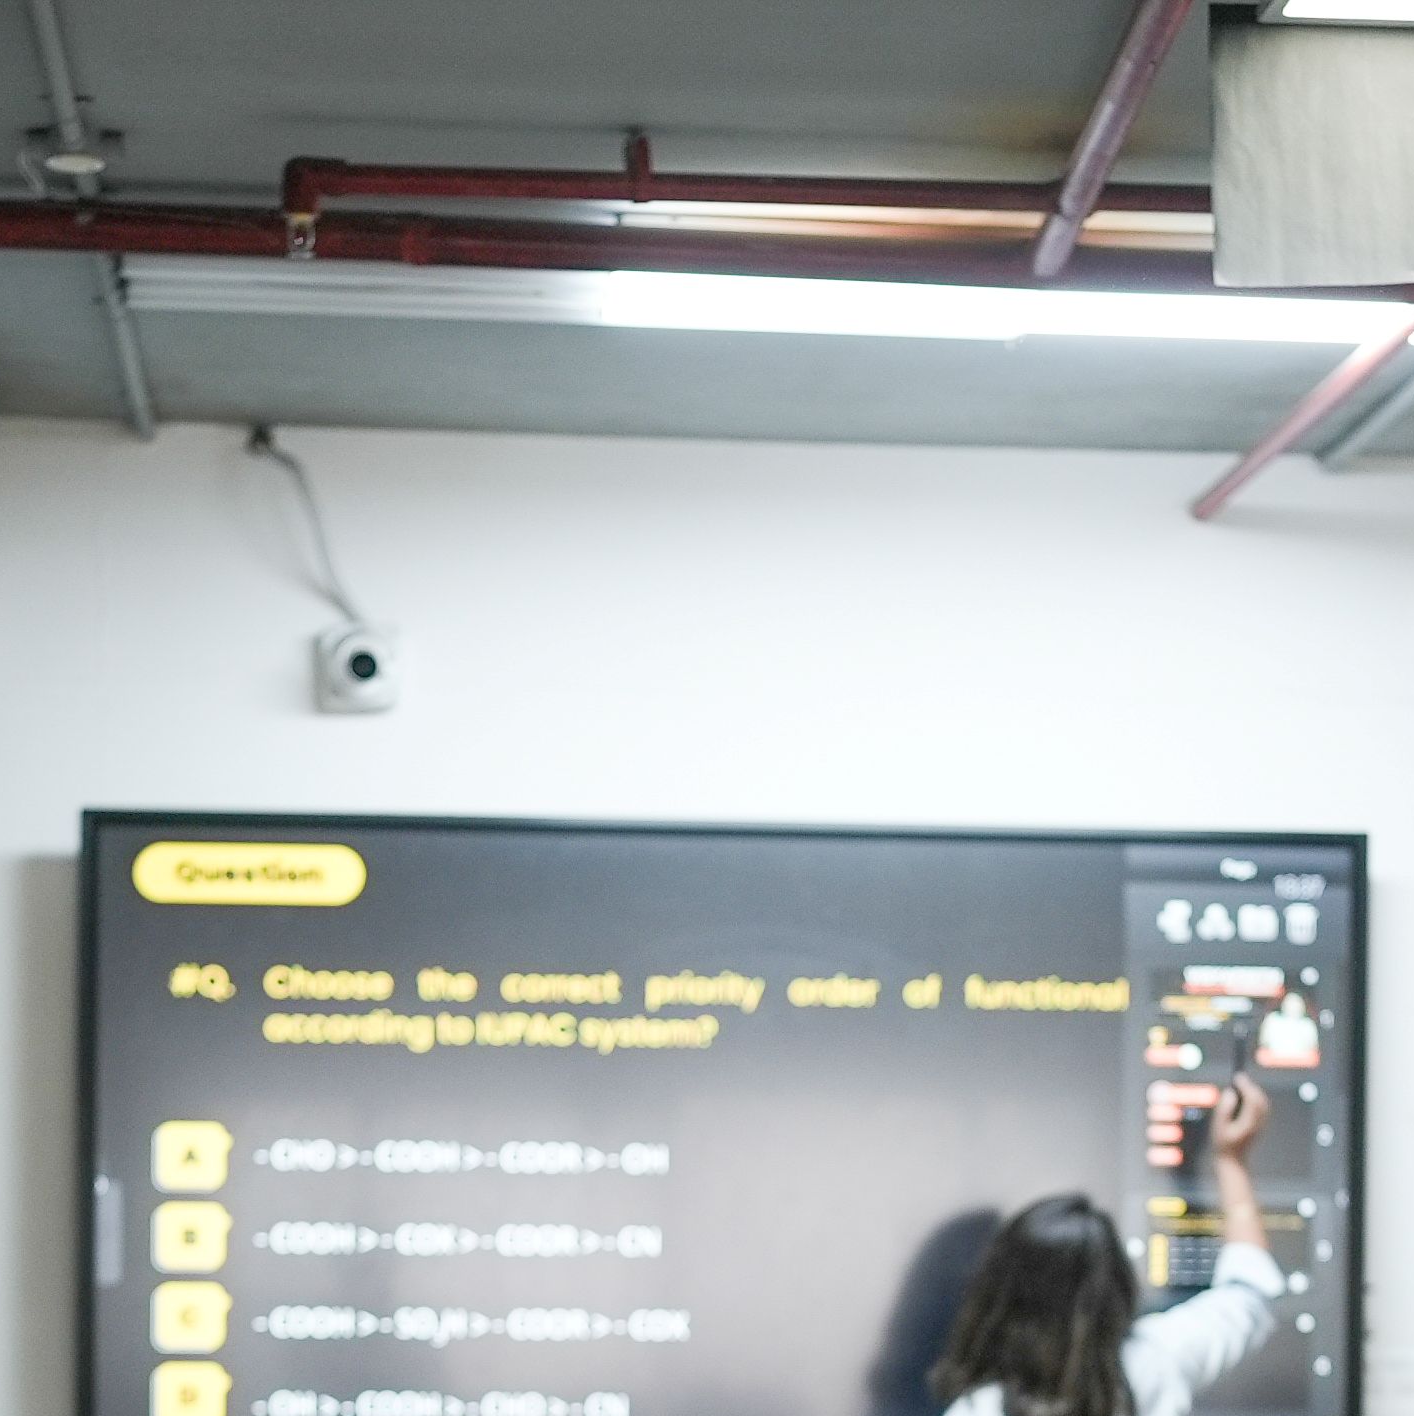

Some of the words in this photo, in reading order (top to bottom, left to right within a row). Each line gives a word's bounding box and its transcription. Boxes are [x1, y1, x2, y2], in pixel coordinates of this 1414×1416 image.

[262, 964, 395, 1001] Choose
[417, 966, 478, 1003] the
[500, 970, 623, 1005] correct
[645, 969, 766, 1014] priority
[786, 971, 882, 1008] order
[902, 972, 943, 1009] of
[964, 973, 1130, 1012] functional
[262, 1009, 435, 1054] according
[436, 1011, 475, 1046] to
[476, 1011, 577, 1047] IUPAC
[578, 1013, 720, 1056] system?
